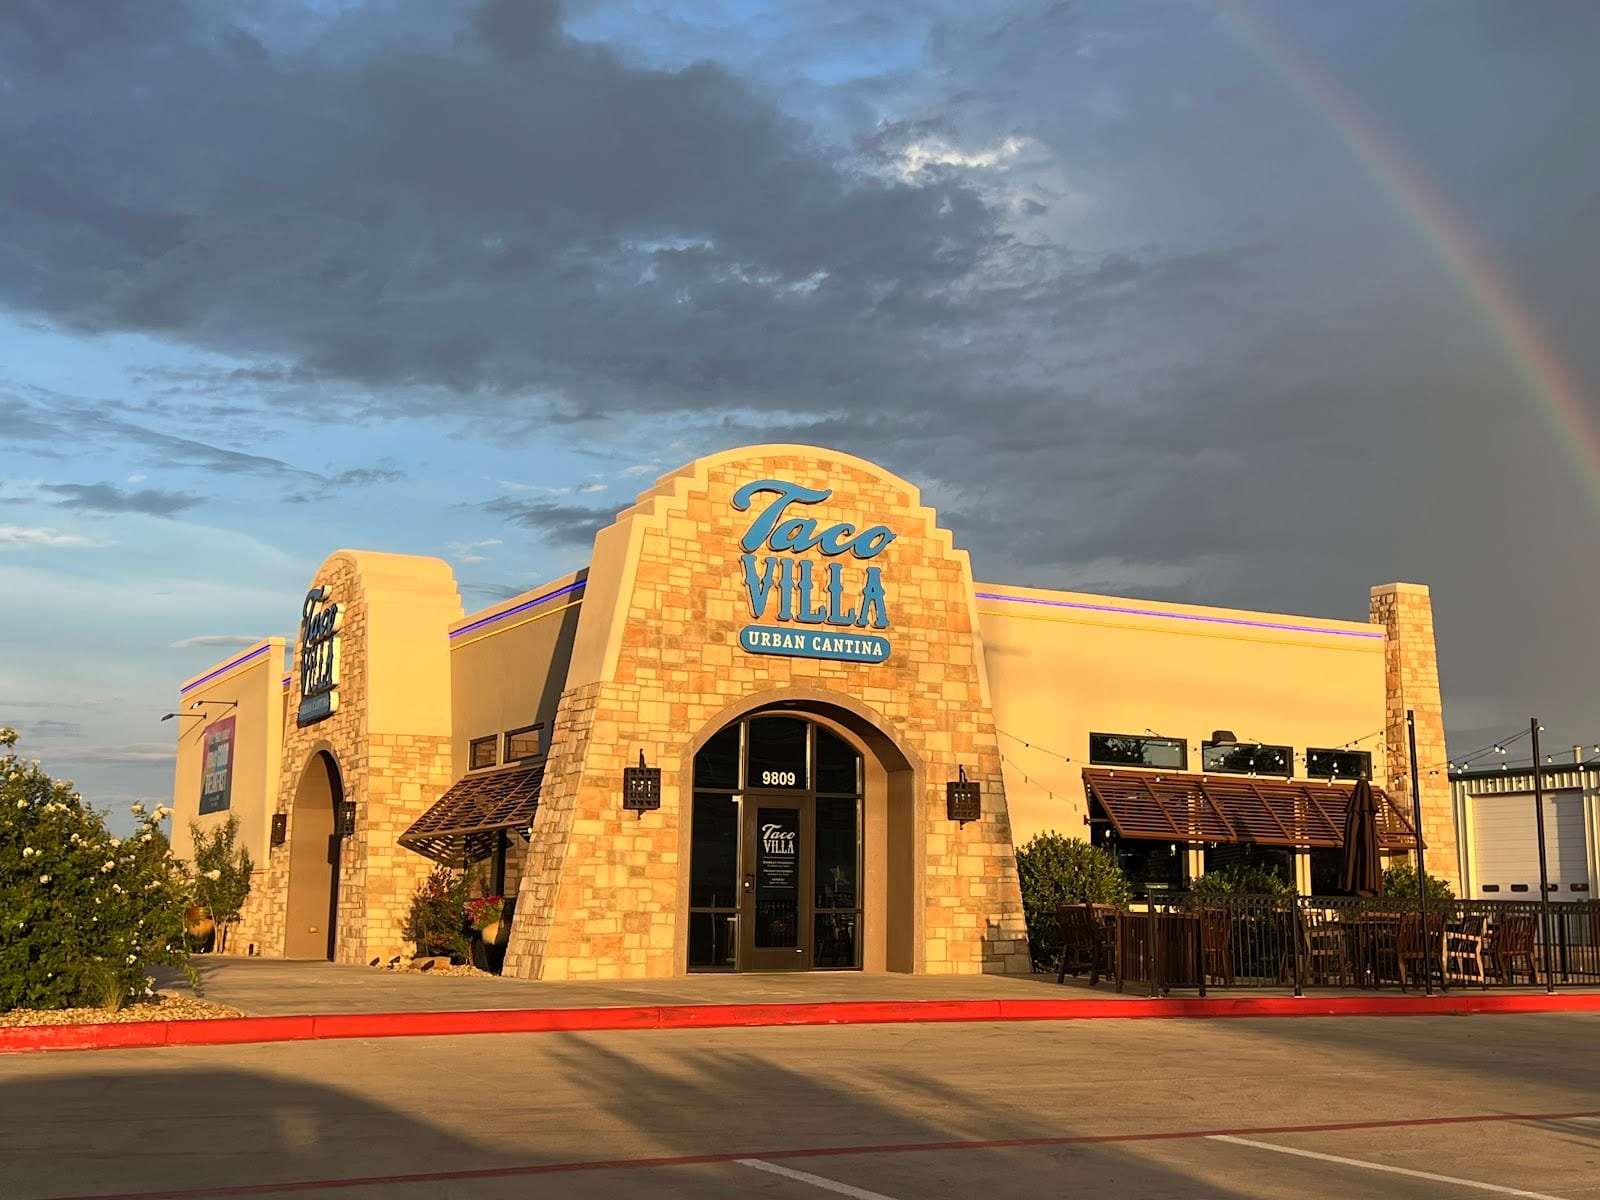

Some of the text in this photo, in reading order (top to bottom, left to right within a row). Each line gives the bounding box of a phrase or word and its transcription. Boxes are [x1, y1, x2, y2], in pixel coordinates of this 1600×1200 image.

[732, 479, 897, 559] Taco
[741, 554, 890, 628] VILLA
[748, 631, 883, 656] URBAN CANTINA
[762, 770, 796, 786] 9809
[761, 823, 796, 840] Taco
[763, 839, 795, 854] VILLA
